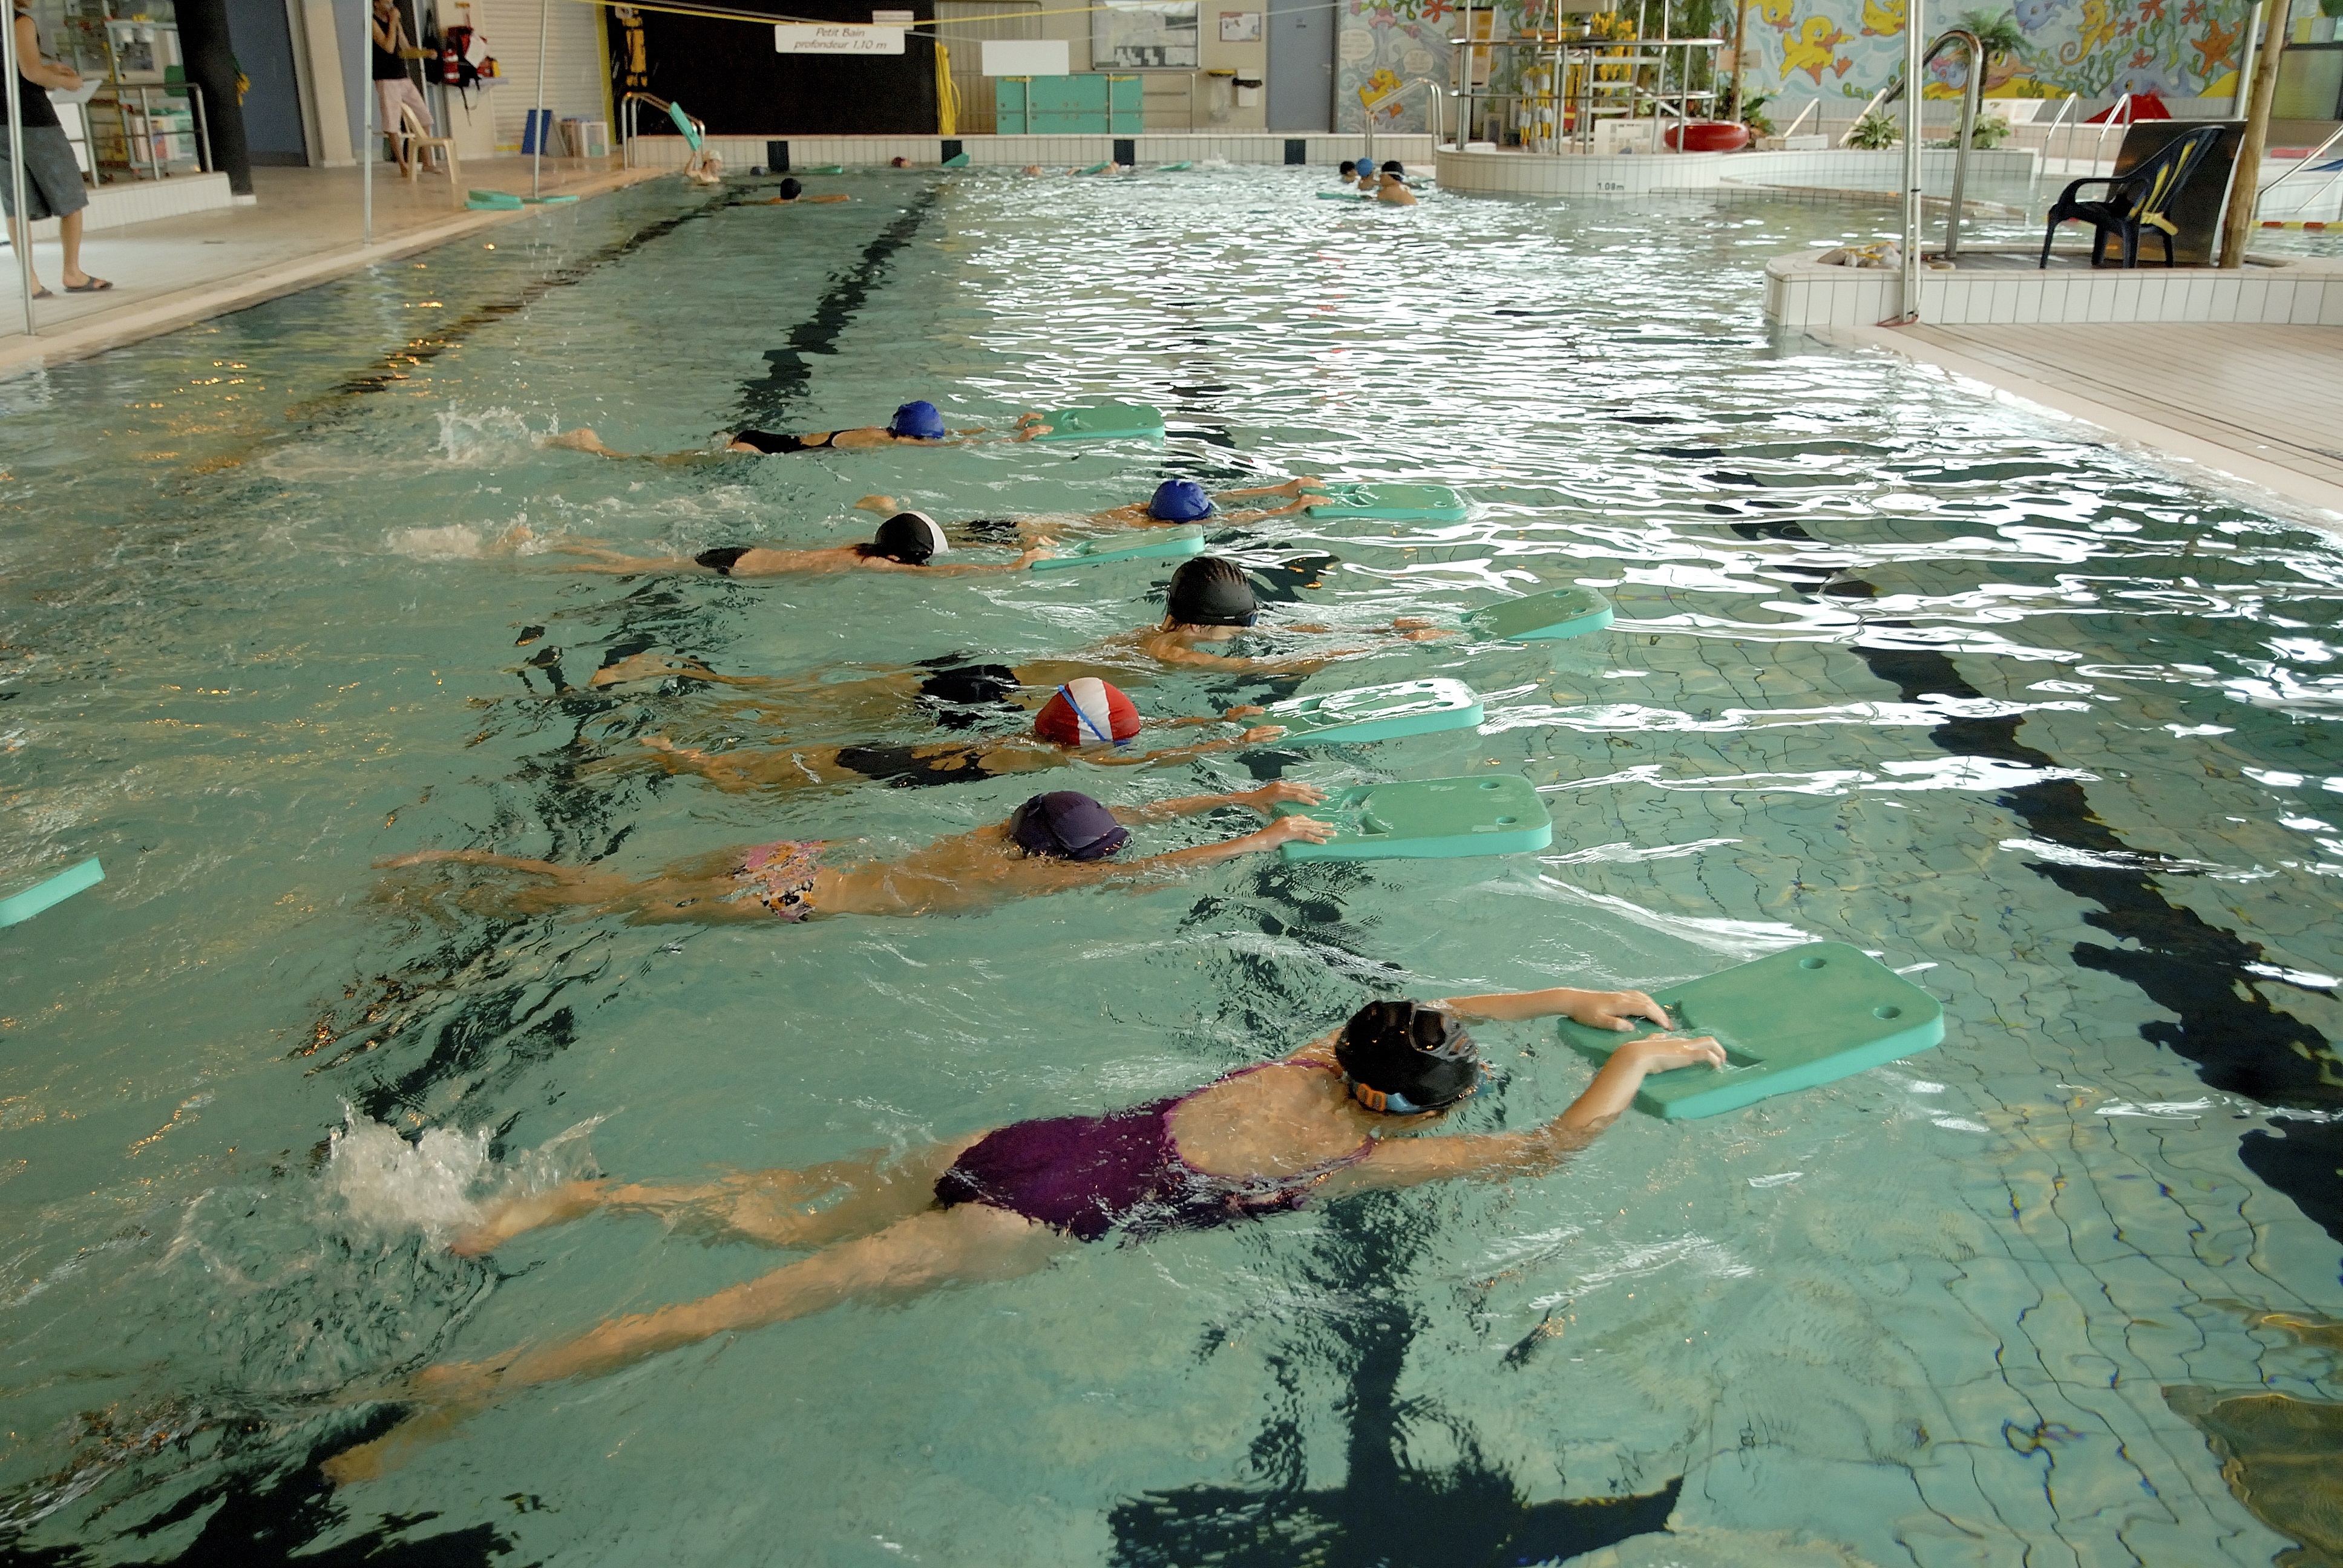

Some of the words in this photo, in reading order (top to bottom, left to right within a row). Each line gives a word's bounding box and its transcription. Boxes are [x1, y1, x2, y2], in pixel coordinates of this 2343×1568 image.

[816, 28, 839, 36] Petit
[842, 28, 865, 37] Bain
[793, 39, 849, 50] profondeur
